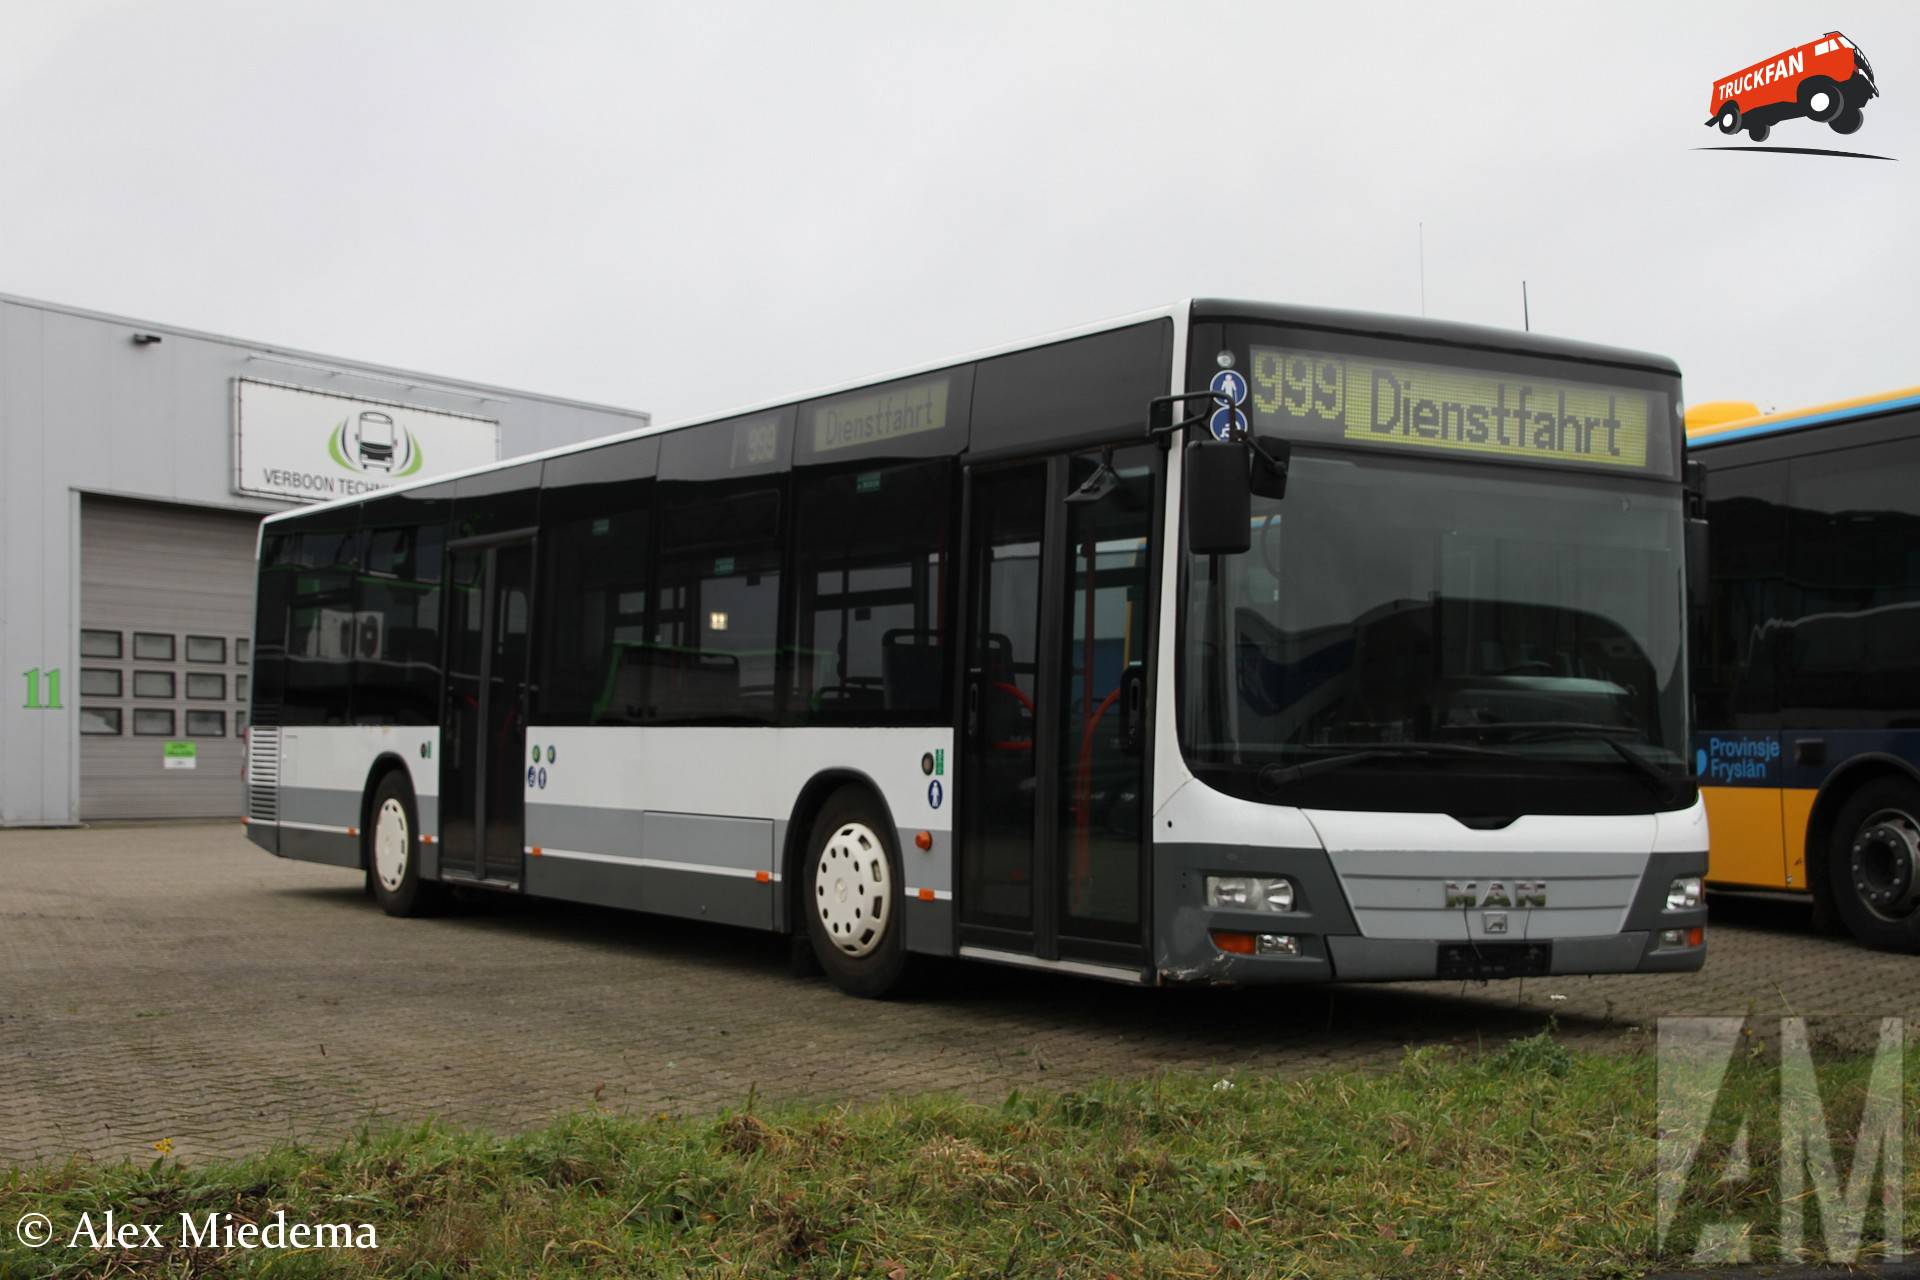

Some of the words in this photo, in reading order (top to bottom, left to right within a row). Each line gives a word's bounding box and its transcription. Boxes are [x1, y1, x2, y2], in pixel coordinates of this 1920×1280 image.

[825, 386, 934, 447] Dienstfahrt
[1254, 350, 1344, 420] 999
[1371, 367, 1622, 457] Dienstfahrt
[263, 468, 335, 492] VERBOON
[22, 667, 64, 710] 11
[1710, 736, 1780, 762] Provinsje
[1444, 880, 1546, 908] MAN
